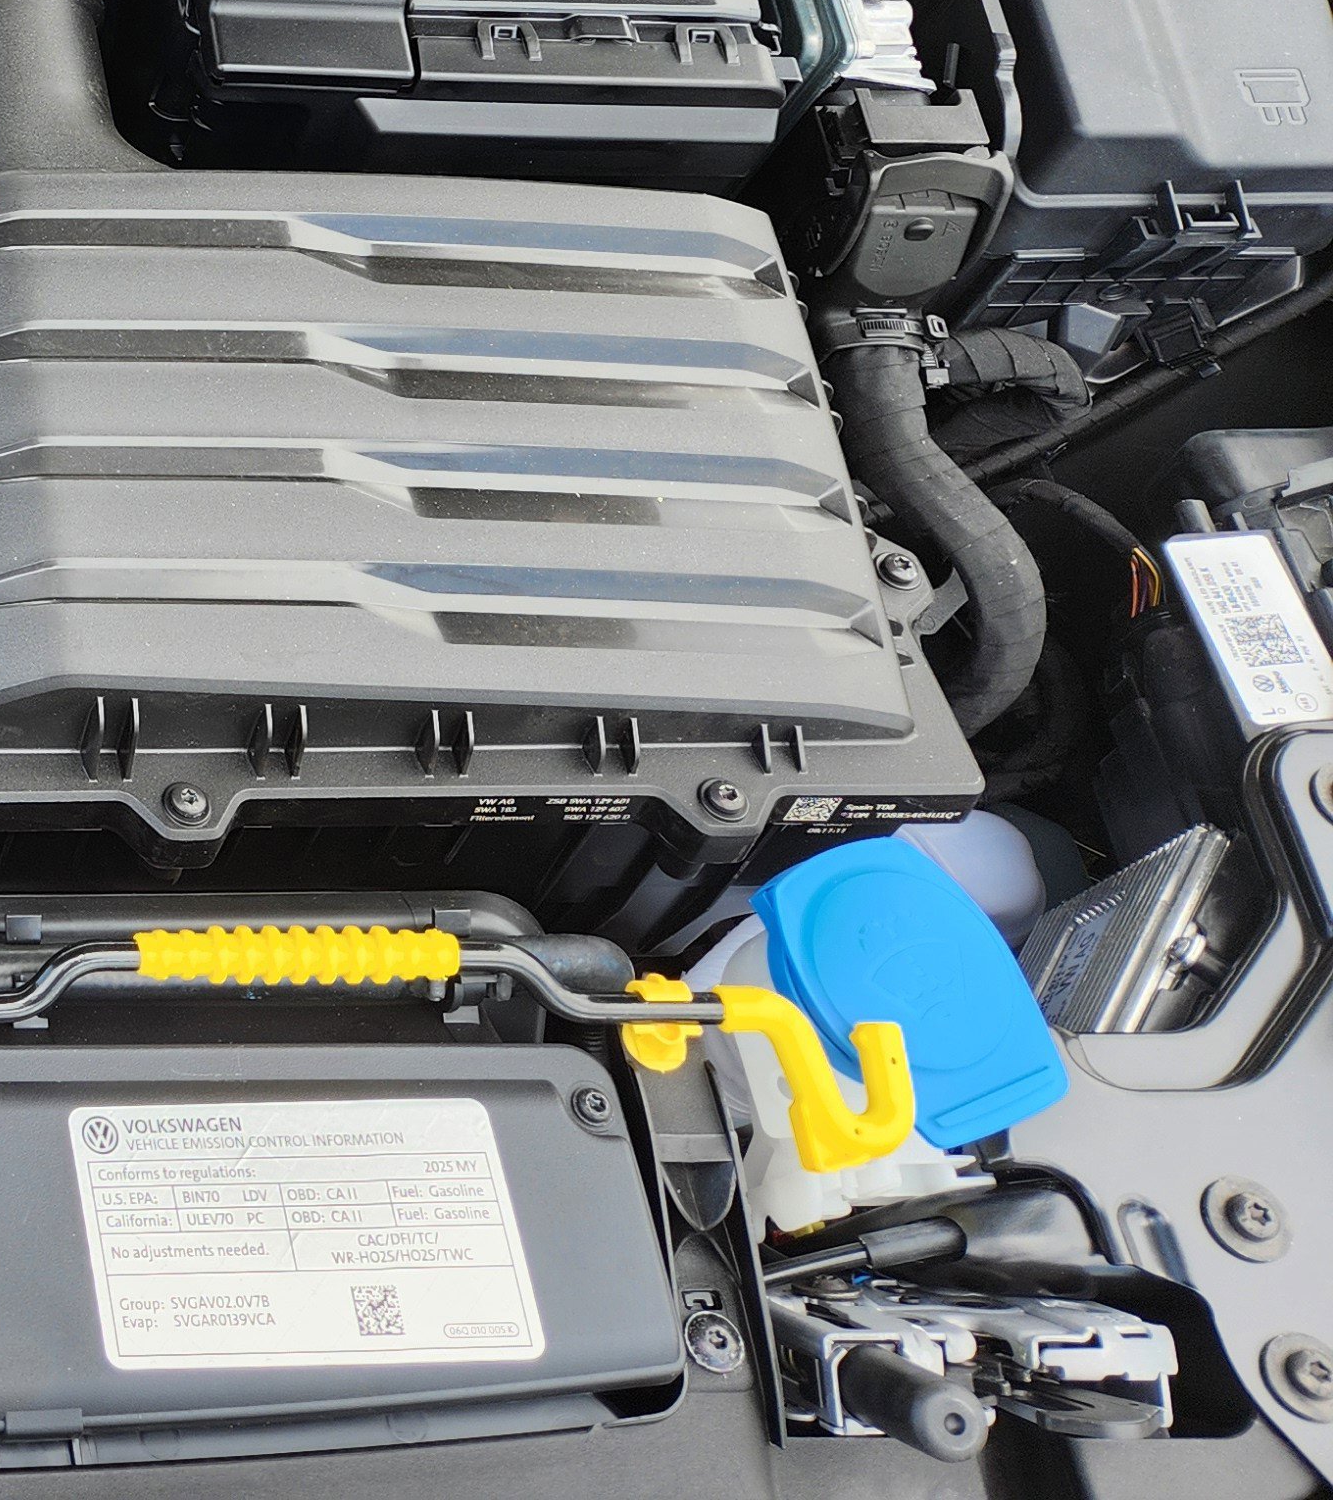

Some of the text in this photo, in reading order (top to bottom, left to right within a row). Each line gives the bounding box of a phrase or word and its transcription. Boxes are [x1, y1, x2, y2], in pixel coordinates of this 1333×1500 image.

[122, 1116, 242, 1134] VOLKSWAGEN
[125, 1132, 404, 1151] VEHICLE EMISSION CONTROL INFORMATION
[97, 1165, 256, 1182] Conforms to regulations:
[423, 1160, 477, 1173] 2025 MY
[182, 1189, 267, 1204] BIN70 LDV
[286, 1187, 358, 1201] OBD: CA II
[391, 1183, 485, 1198] Fuel: Gasoline
[101, 1191, 159, 1206] U.S. EPA:
[105, 1213, 173, 1228] California:
[186, 1211, 265, 1226] ULEV70 PC
[291, 1209, 363, 1224] OBD: CA II
[396, 1206, 491, 1221] Fuel: Gasoline
[110, 1242, 270, 1263] No adjustments needed.
[119, 1297, 165, 1314] Group:
[121, 1315, 159, 1332] Evap:
